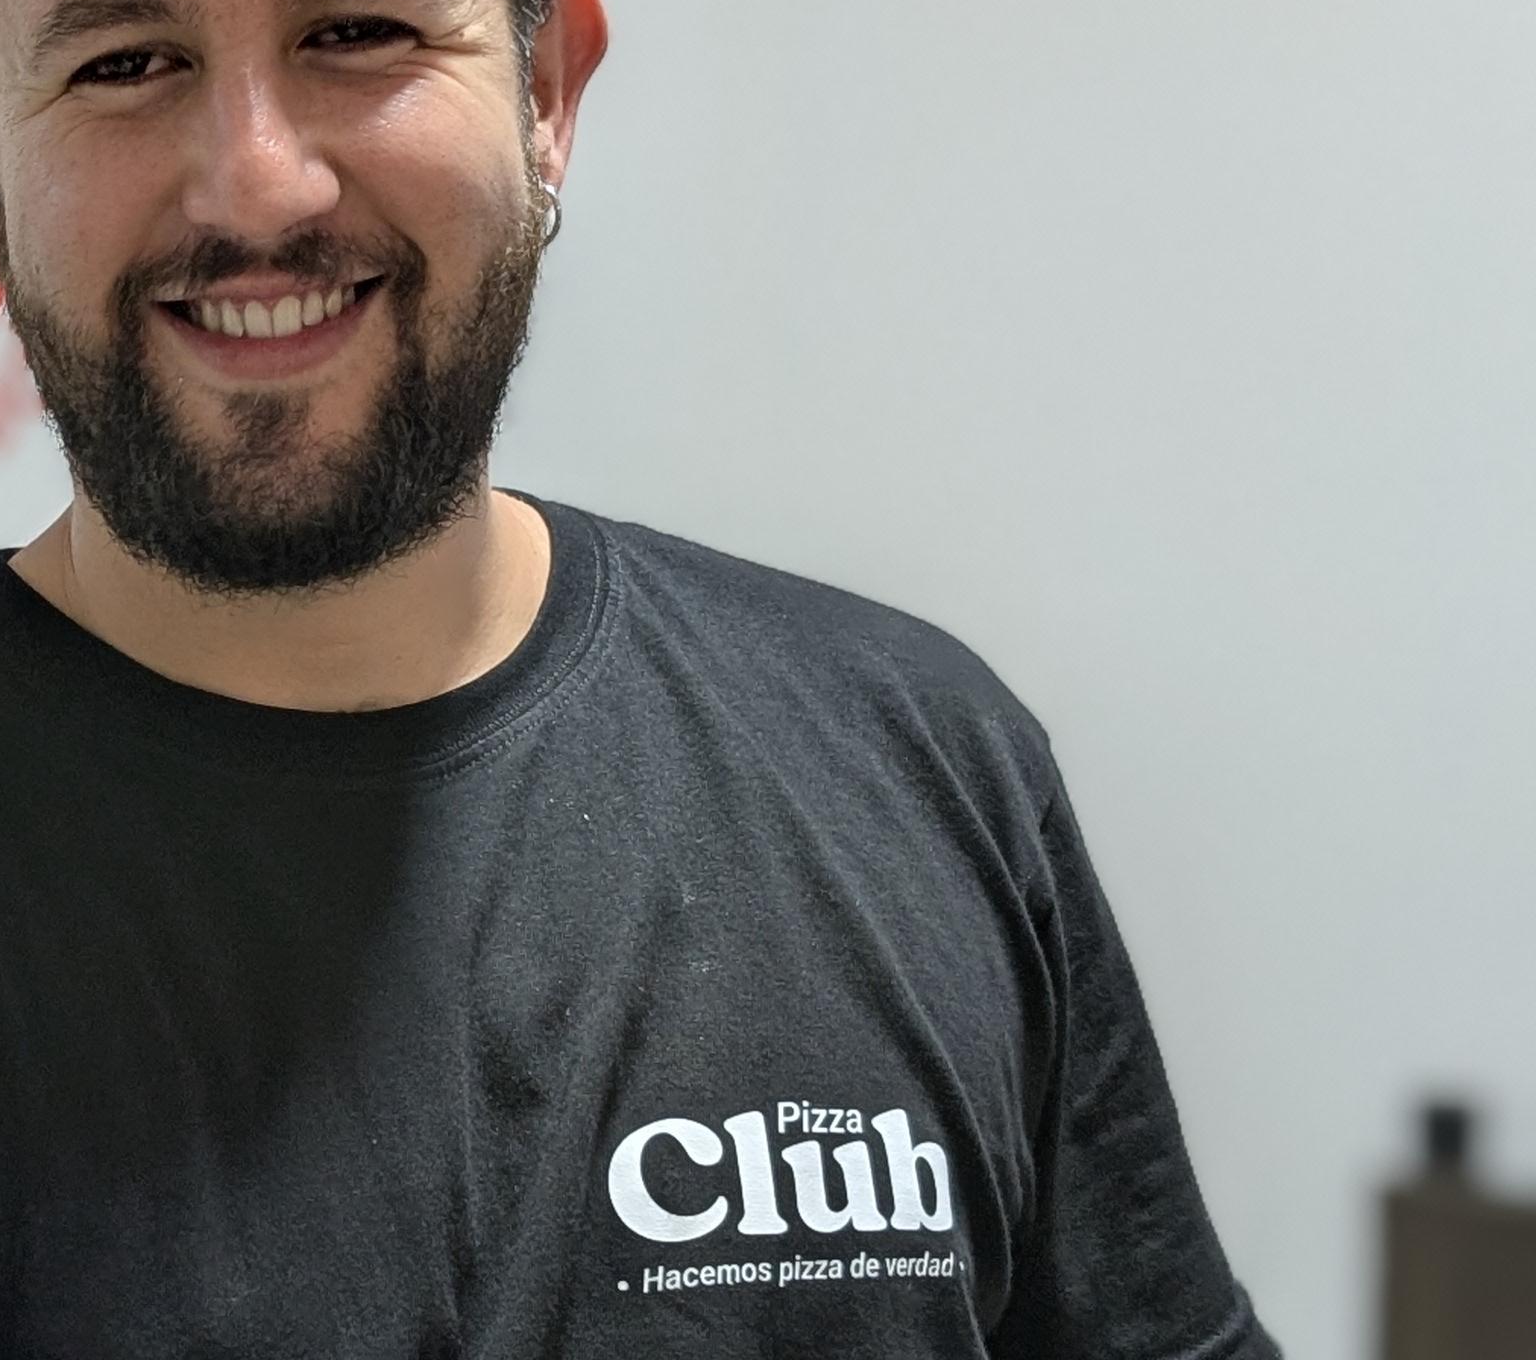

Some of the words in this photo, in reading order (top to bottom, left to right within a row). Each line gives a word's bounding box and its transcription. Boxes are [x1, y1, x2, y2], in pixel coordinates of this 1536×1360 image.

[777, 1100, 864, 1134] Pizza
[608, 1108, 954, 1243] Club
[642, 1262, 772, 1294] Hacemos
[778, 1254, 843, 1287] pizza
[849, 1251, 880, 1279] de
[884, 1250, 954, 1277] verdad
